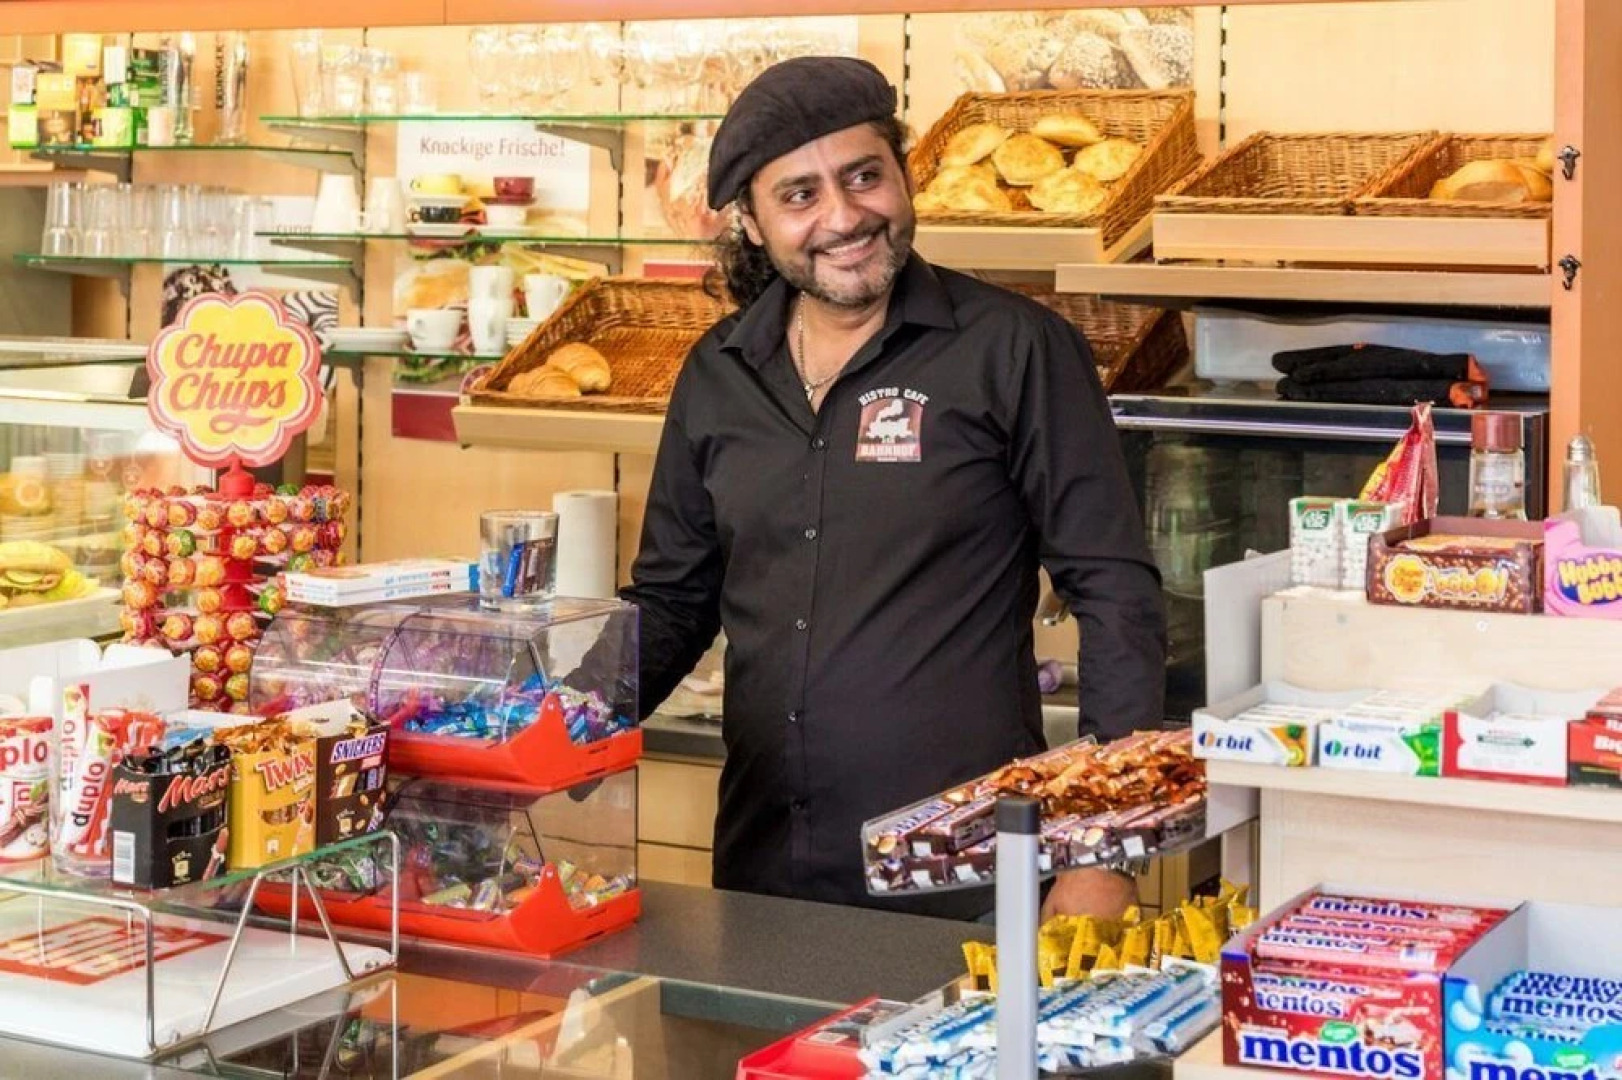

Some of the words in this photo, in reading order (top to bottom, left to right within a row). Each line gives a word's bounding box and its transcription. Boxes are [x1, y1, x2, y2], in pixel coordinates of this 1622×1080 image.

[419, 136, 493, 160] Knackige
[498, 137, 565, 158] Frische!
[175, 334, 292, 378] Chupa
[169, 373, 287, 433] Chups
[858, 387, 899, 406] BISTRO
[332, 733, 386, 761] SNICKERS
[1198, 730, 1254, 752] Orbit
[1324, 739, 1382, 760] Orbit
[255, 746, 314, 792] Twix
[72, 761, 106, 826] duplo
[157, 763, 231, 813] Mars
[1312, 898, 1427, 919] mentos
[1243, 1034, 1421, 1078] mentos
